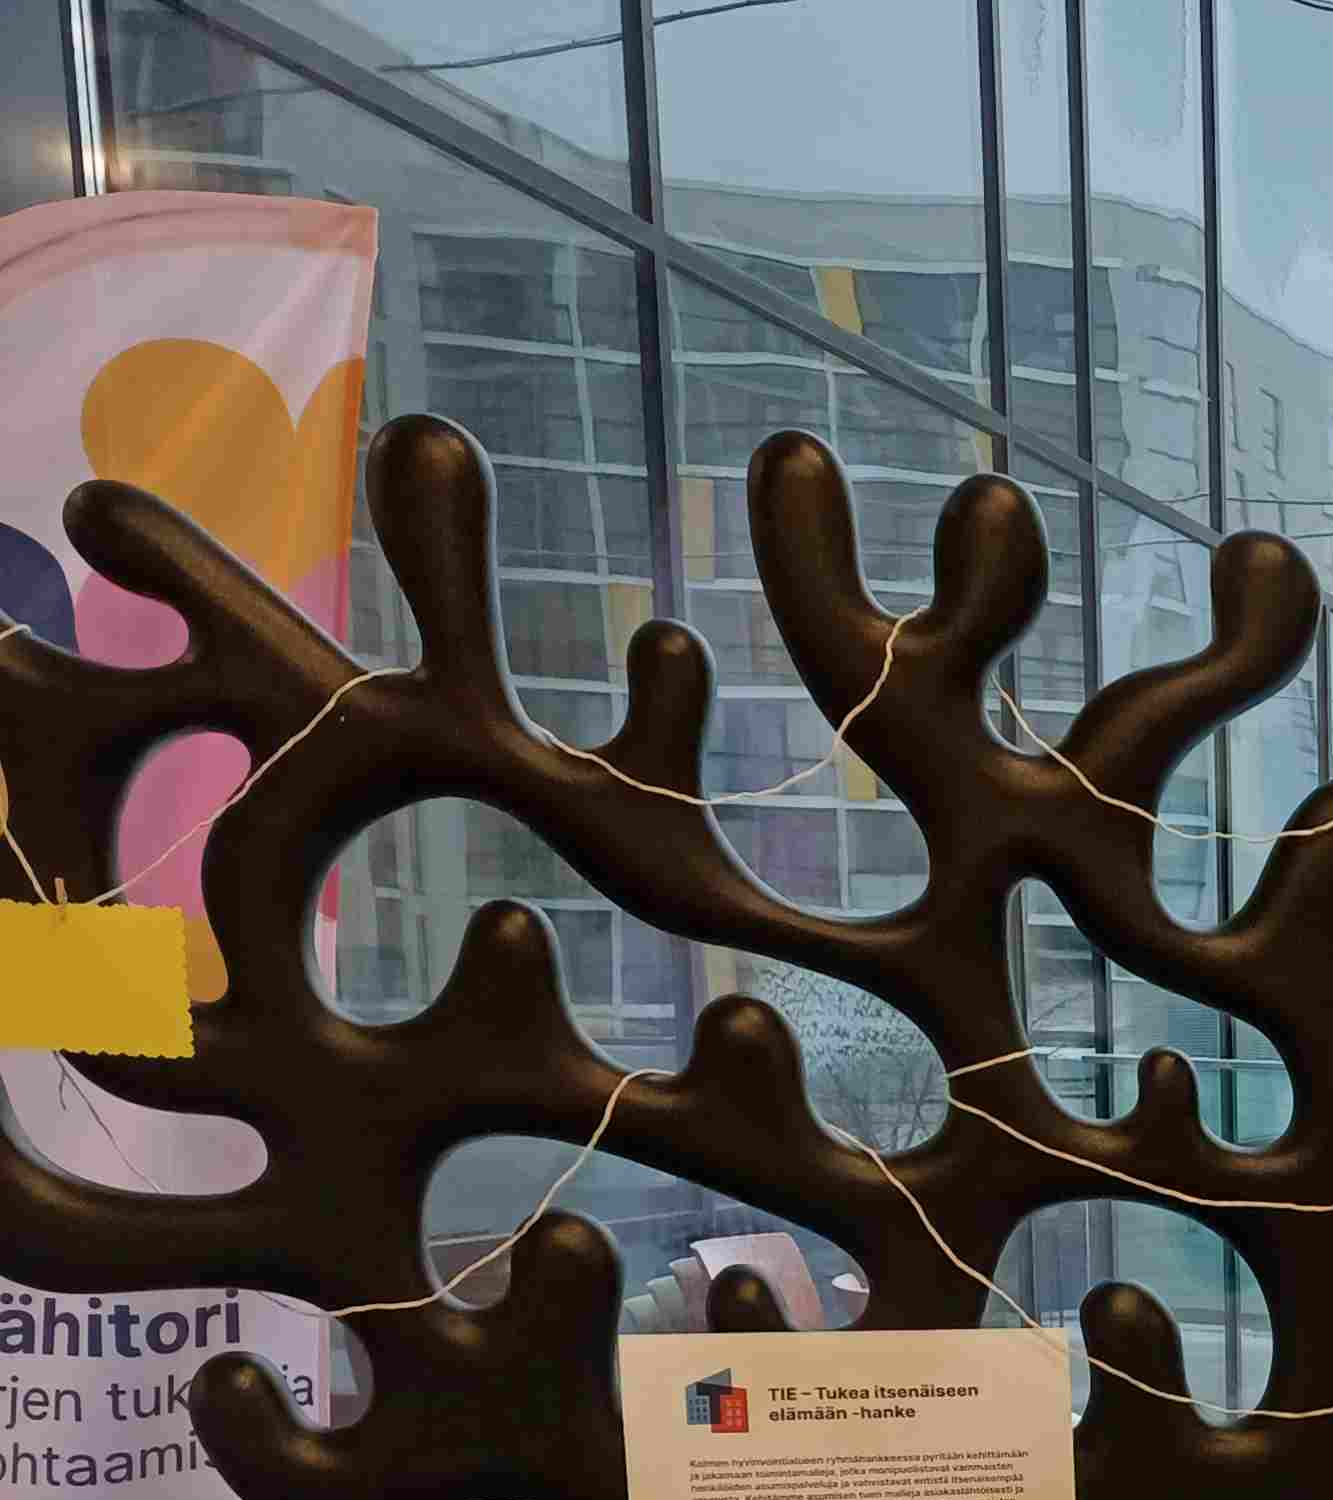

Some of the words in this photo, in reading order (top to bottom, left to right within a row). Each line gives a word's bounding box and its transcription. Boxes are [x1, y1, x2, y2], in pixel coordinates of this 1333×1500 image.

[768, 1387, 798, 1401] TIE
[816, 1385, 870, 1401] Tukea
[873, 1383, 979, 1400] itsenäiseen
[769, 1406, 848, 1421] elämään
[851, 1404, 917, 1420] -hanke
